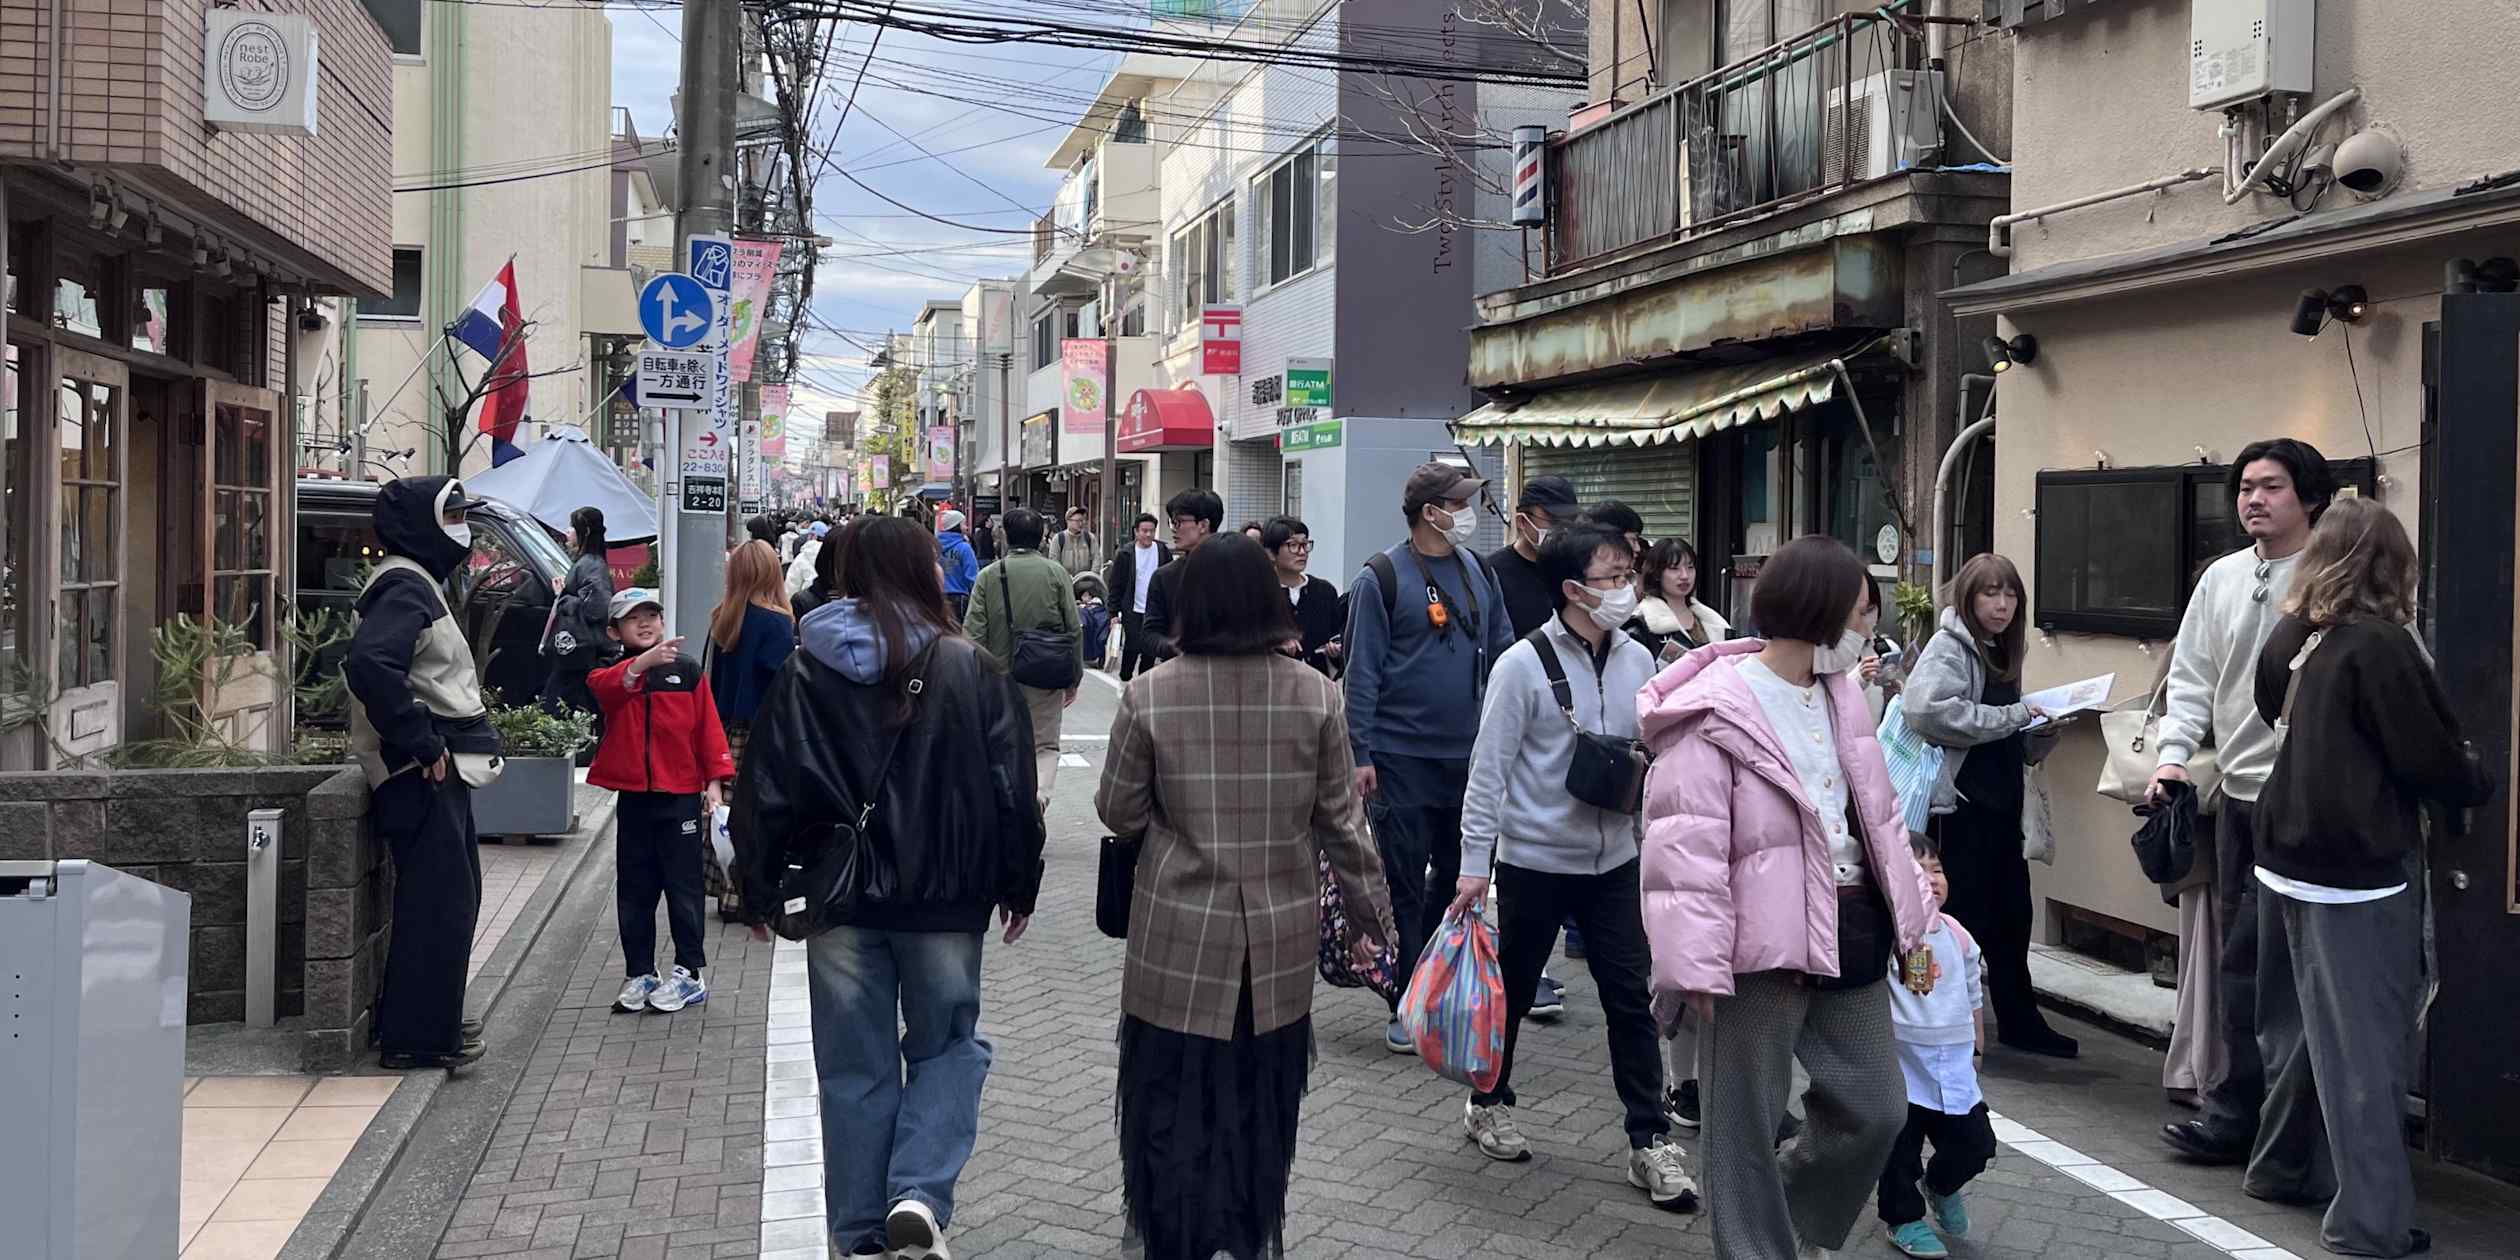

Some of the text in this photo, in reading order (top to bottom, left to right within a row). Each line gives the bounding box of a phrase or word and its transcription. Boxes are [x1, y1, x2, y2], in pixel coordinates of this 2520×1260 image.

[240, 44, 268, 53] nest
[240, 53, 269, 63] Robe
[1433, 221, 1452, 274] Two
[643, 357, 706, 373] 自転車を除く
[715, 294, 729, 429] オーダーメイドワイシャツ
[643, 375, 706, 390] 一方通行
[692, 496, 721, 507] 2-20
